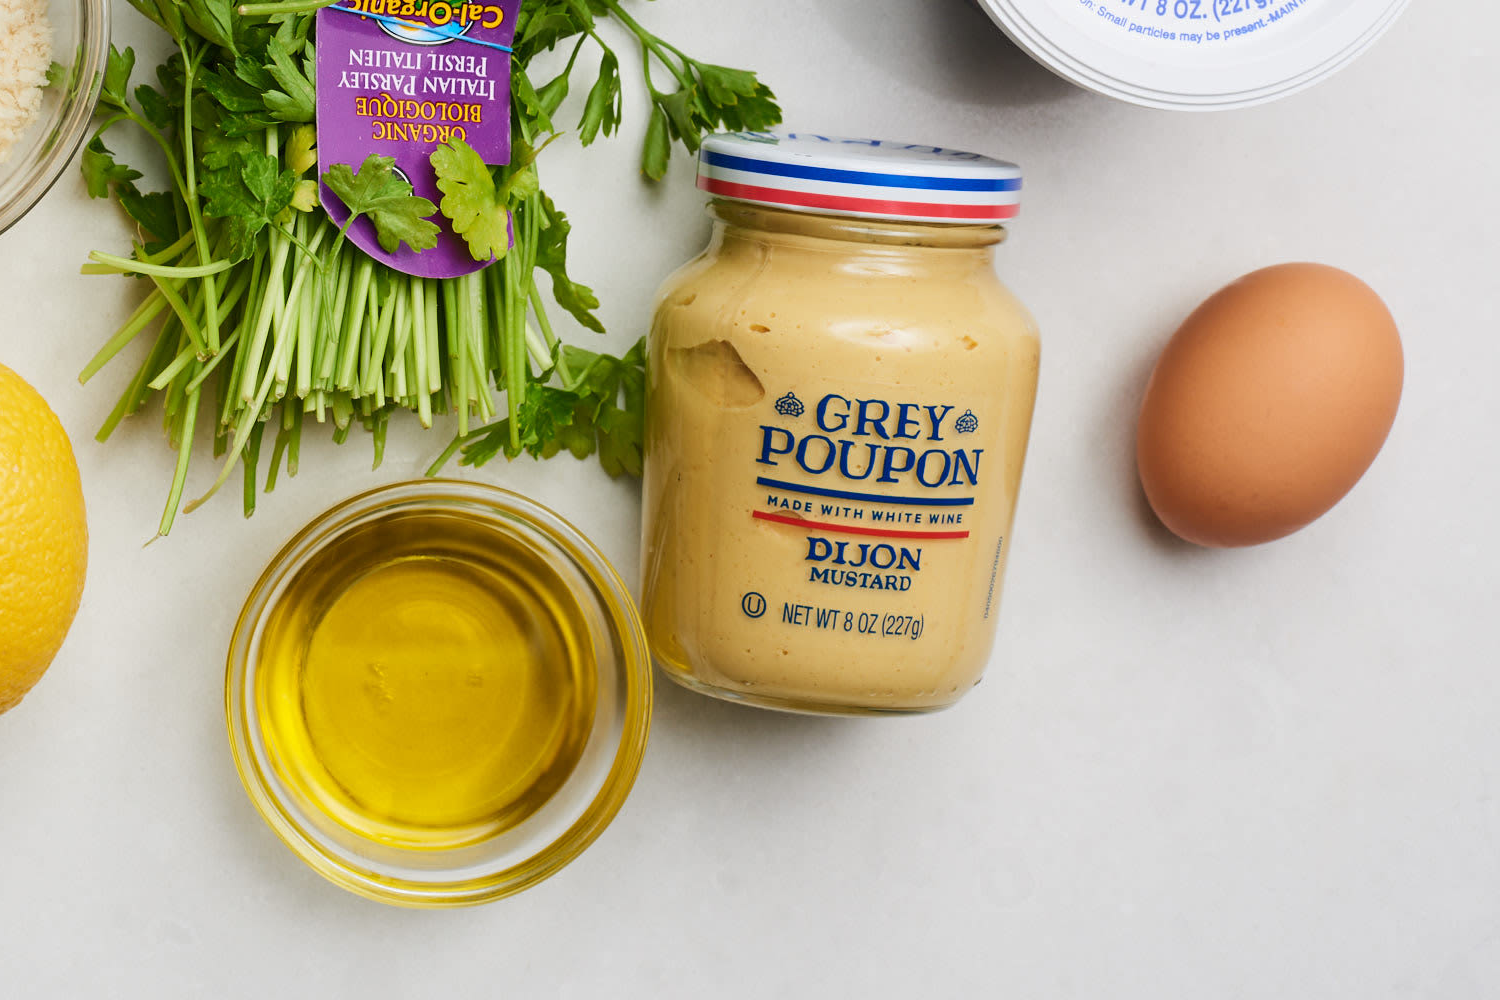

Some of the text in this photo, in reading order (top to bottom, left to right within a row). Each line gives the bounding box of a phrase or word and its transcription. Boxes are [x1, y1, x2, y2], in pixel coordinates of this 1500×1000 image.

[1097, 5, 1128, 27] Small
[1128, 21, 1176, 41] particles
[1179, 31, 1203, 43] may
[1206, 30, 1220, 41] be
[1174, 0, 1207, 20] OZ.
[349, 48, 488, 78] PERSIL ITALIEN
[337, 71, 495, 101] ITALIAN PARSLEY
[355, 93, 482, 123] BIOLOGIQUE
[372, 121, 467, 145] ORGANIC
[816, 393, 955, 442] GREY
[755, 425, 985, 488] POUPON
[767, 495, 963, 525] MADE WITH WHITE WINE
[805, 536, 922, 572] DIJON
[808, 567, 913, 592] MUSTARD
[782, 602, 925, 641] NET WT 8 OZ (227g)
